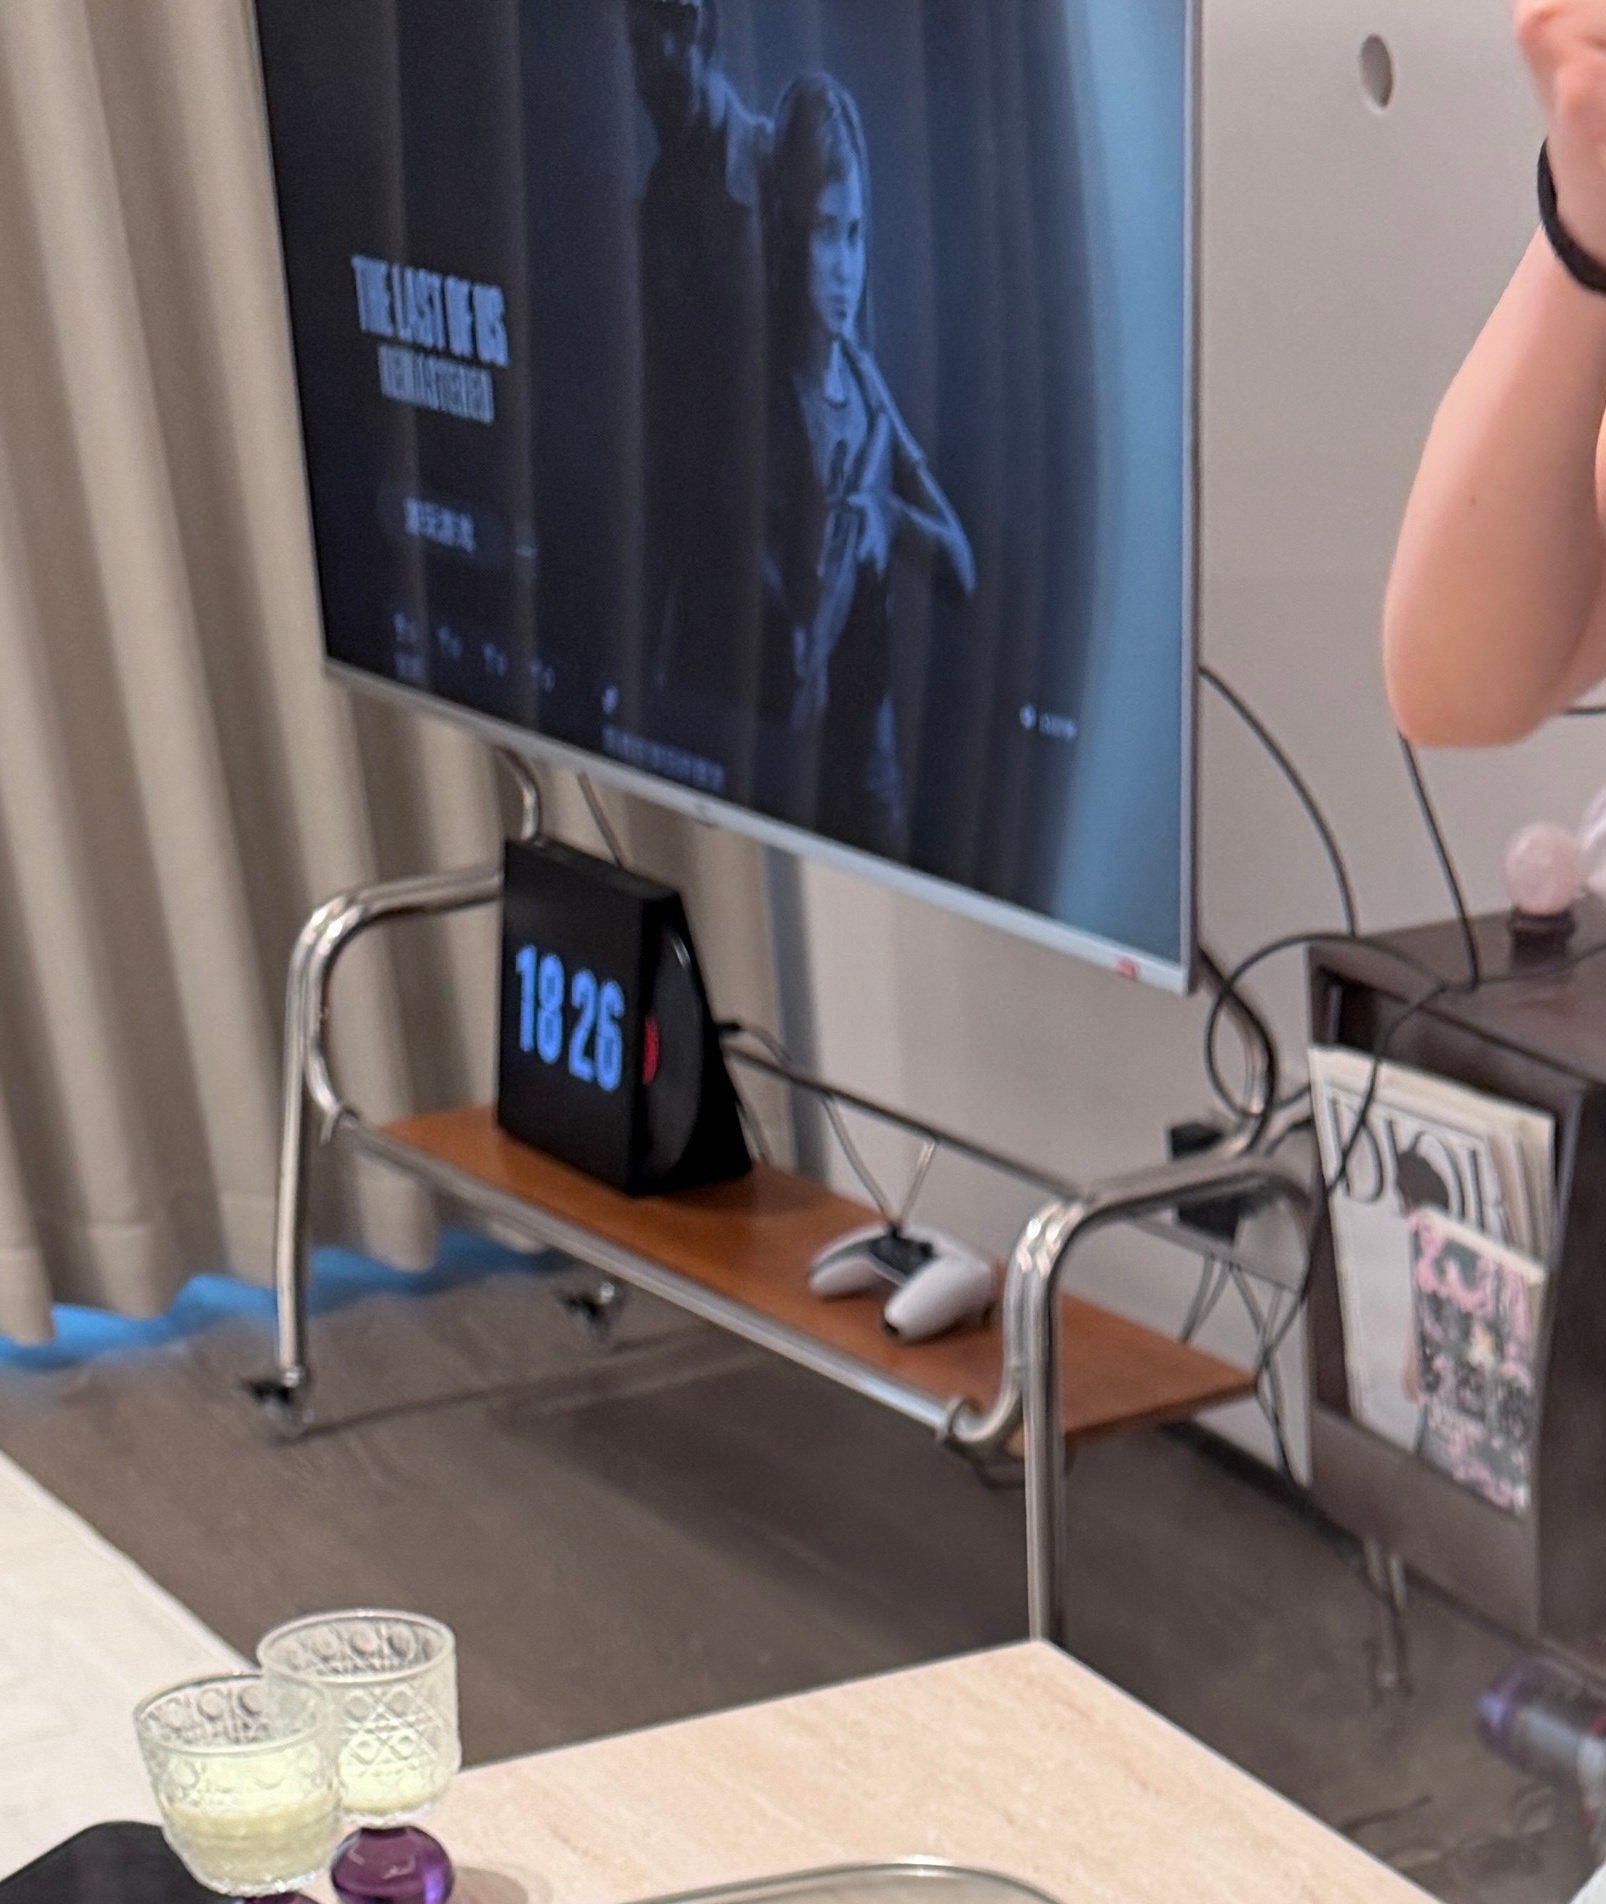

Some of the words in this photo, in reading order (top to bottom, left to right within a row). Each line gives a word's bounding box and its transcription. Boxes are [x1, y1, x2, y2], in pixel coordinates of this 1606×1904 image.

[351, 254, 395, 337] THE
[392, 262, 447, 352] LAST
[515, 944, 565, 1065] 18
[568, 968, 625, 1093] 26
